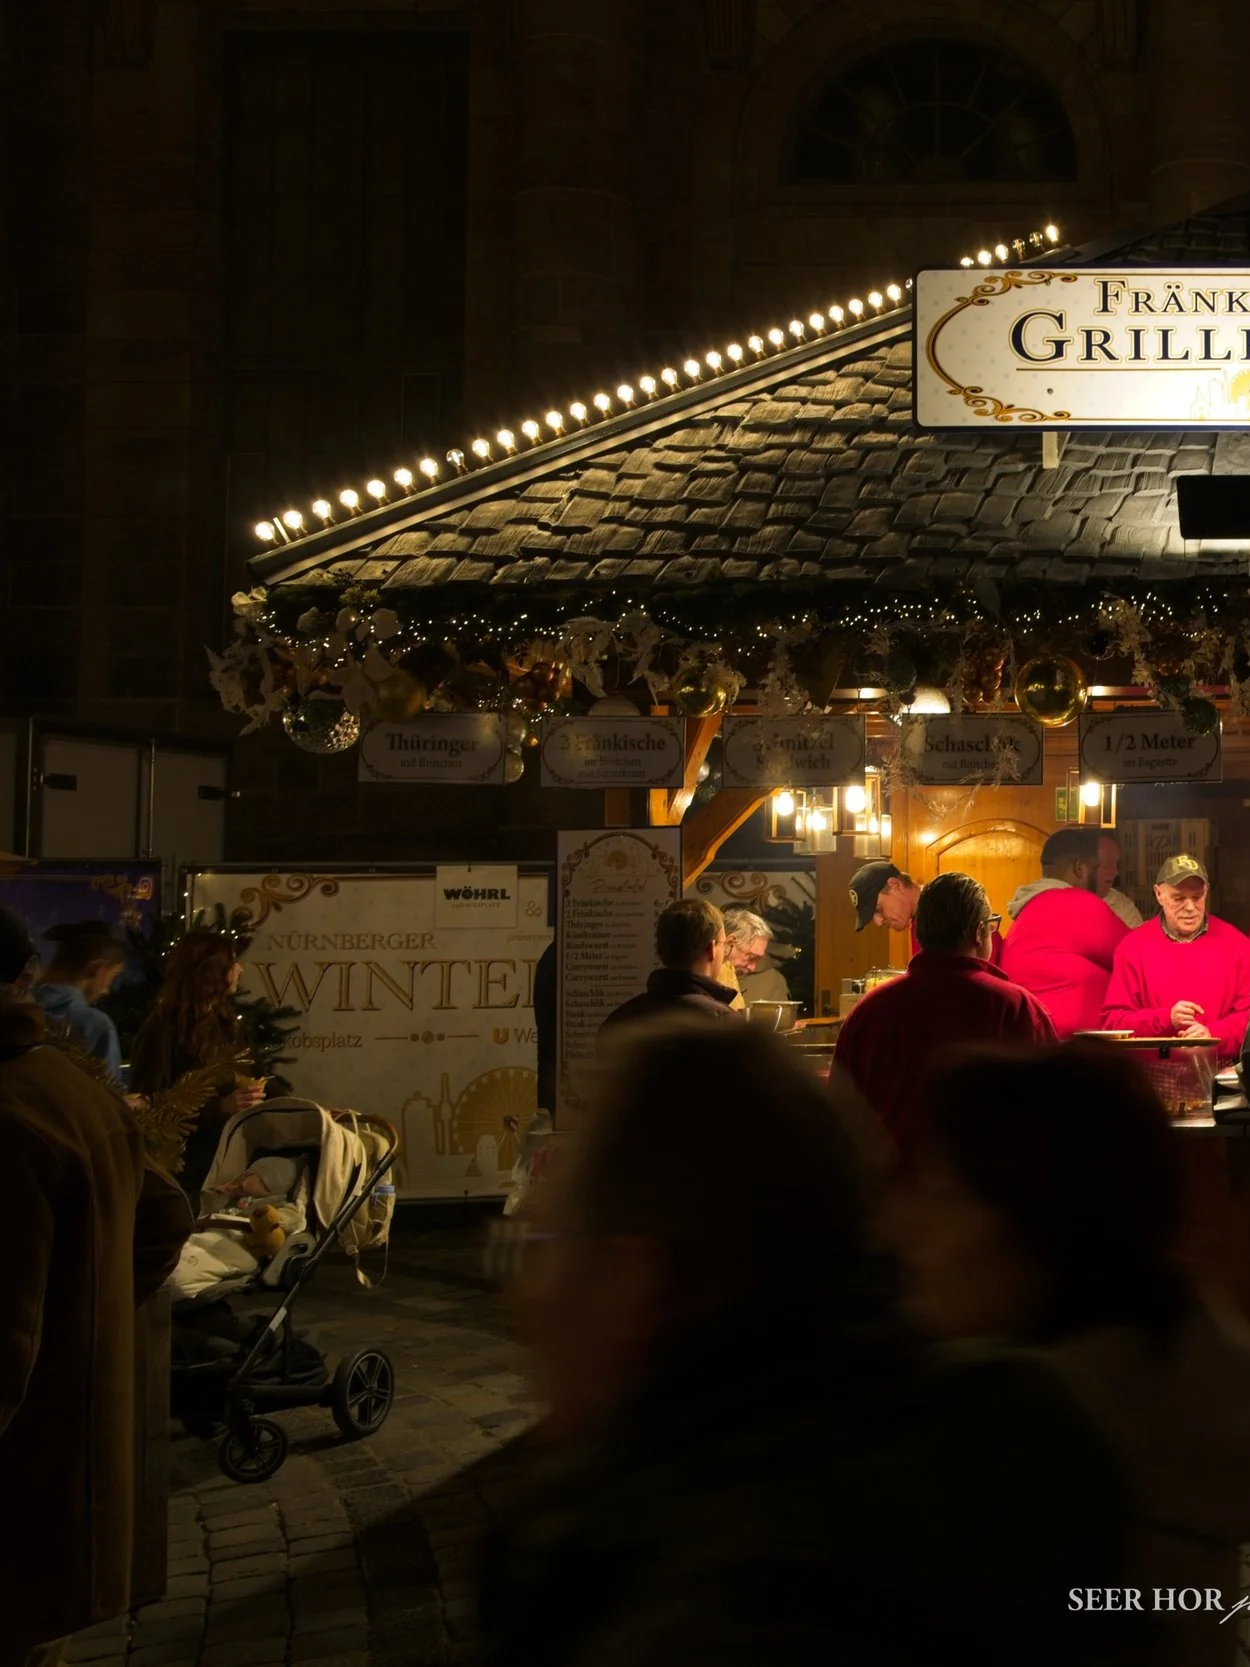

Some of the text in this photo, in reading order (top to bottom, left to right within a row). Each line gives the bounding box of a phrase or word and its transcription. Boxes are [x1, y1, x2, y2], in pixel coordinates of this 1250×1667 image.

[385, 732, 479, 757] Thüringer
[1105, 732, 1196, 753] 1/2 Meter
[960, 758, 998, 769] Brötche
[443, 886, 511, 900] WÖHRL
[267, 932, 438, 951] NÜRNBERGER
